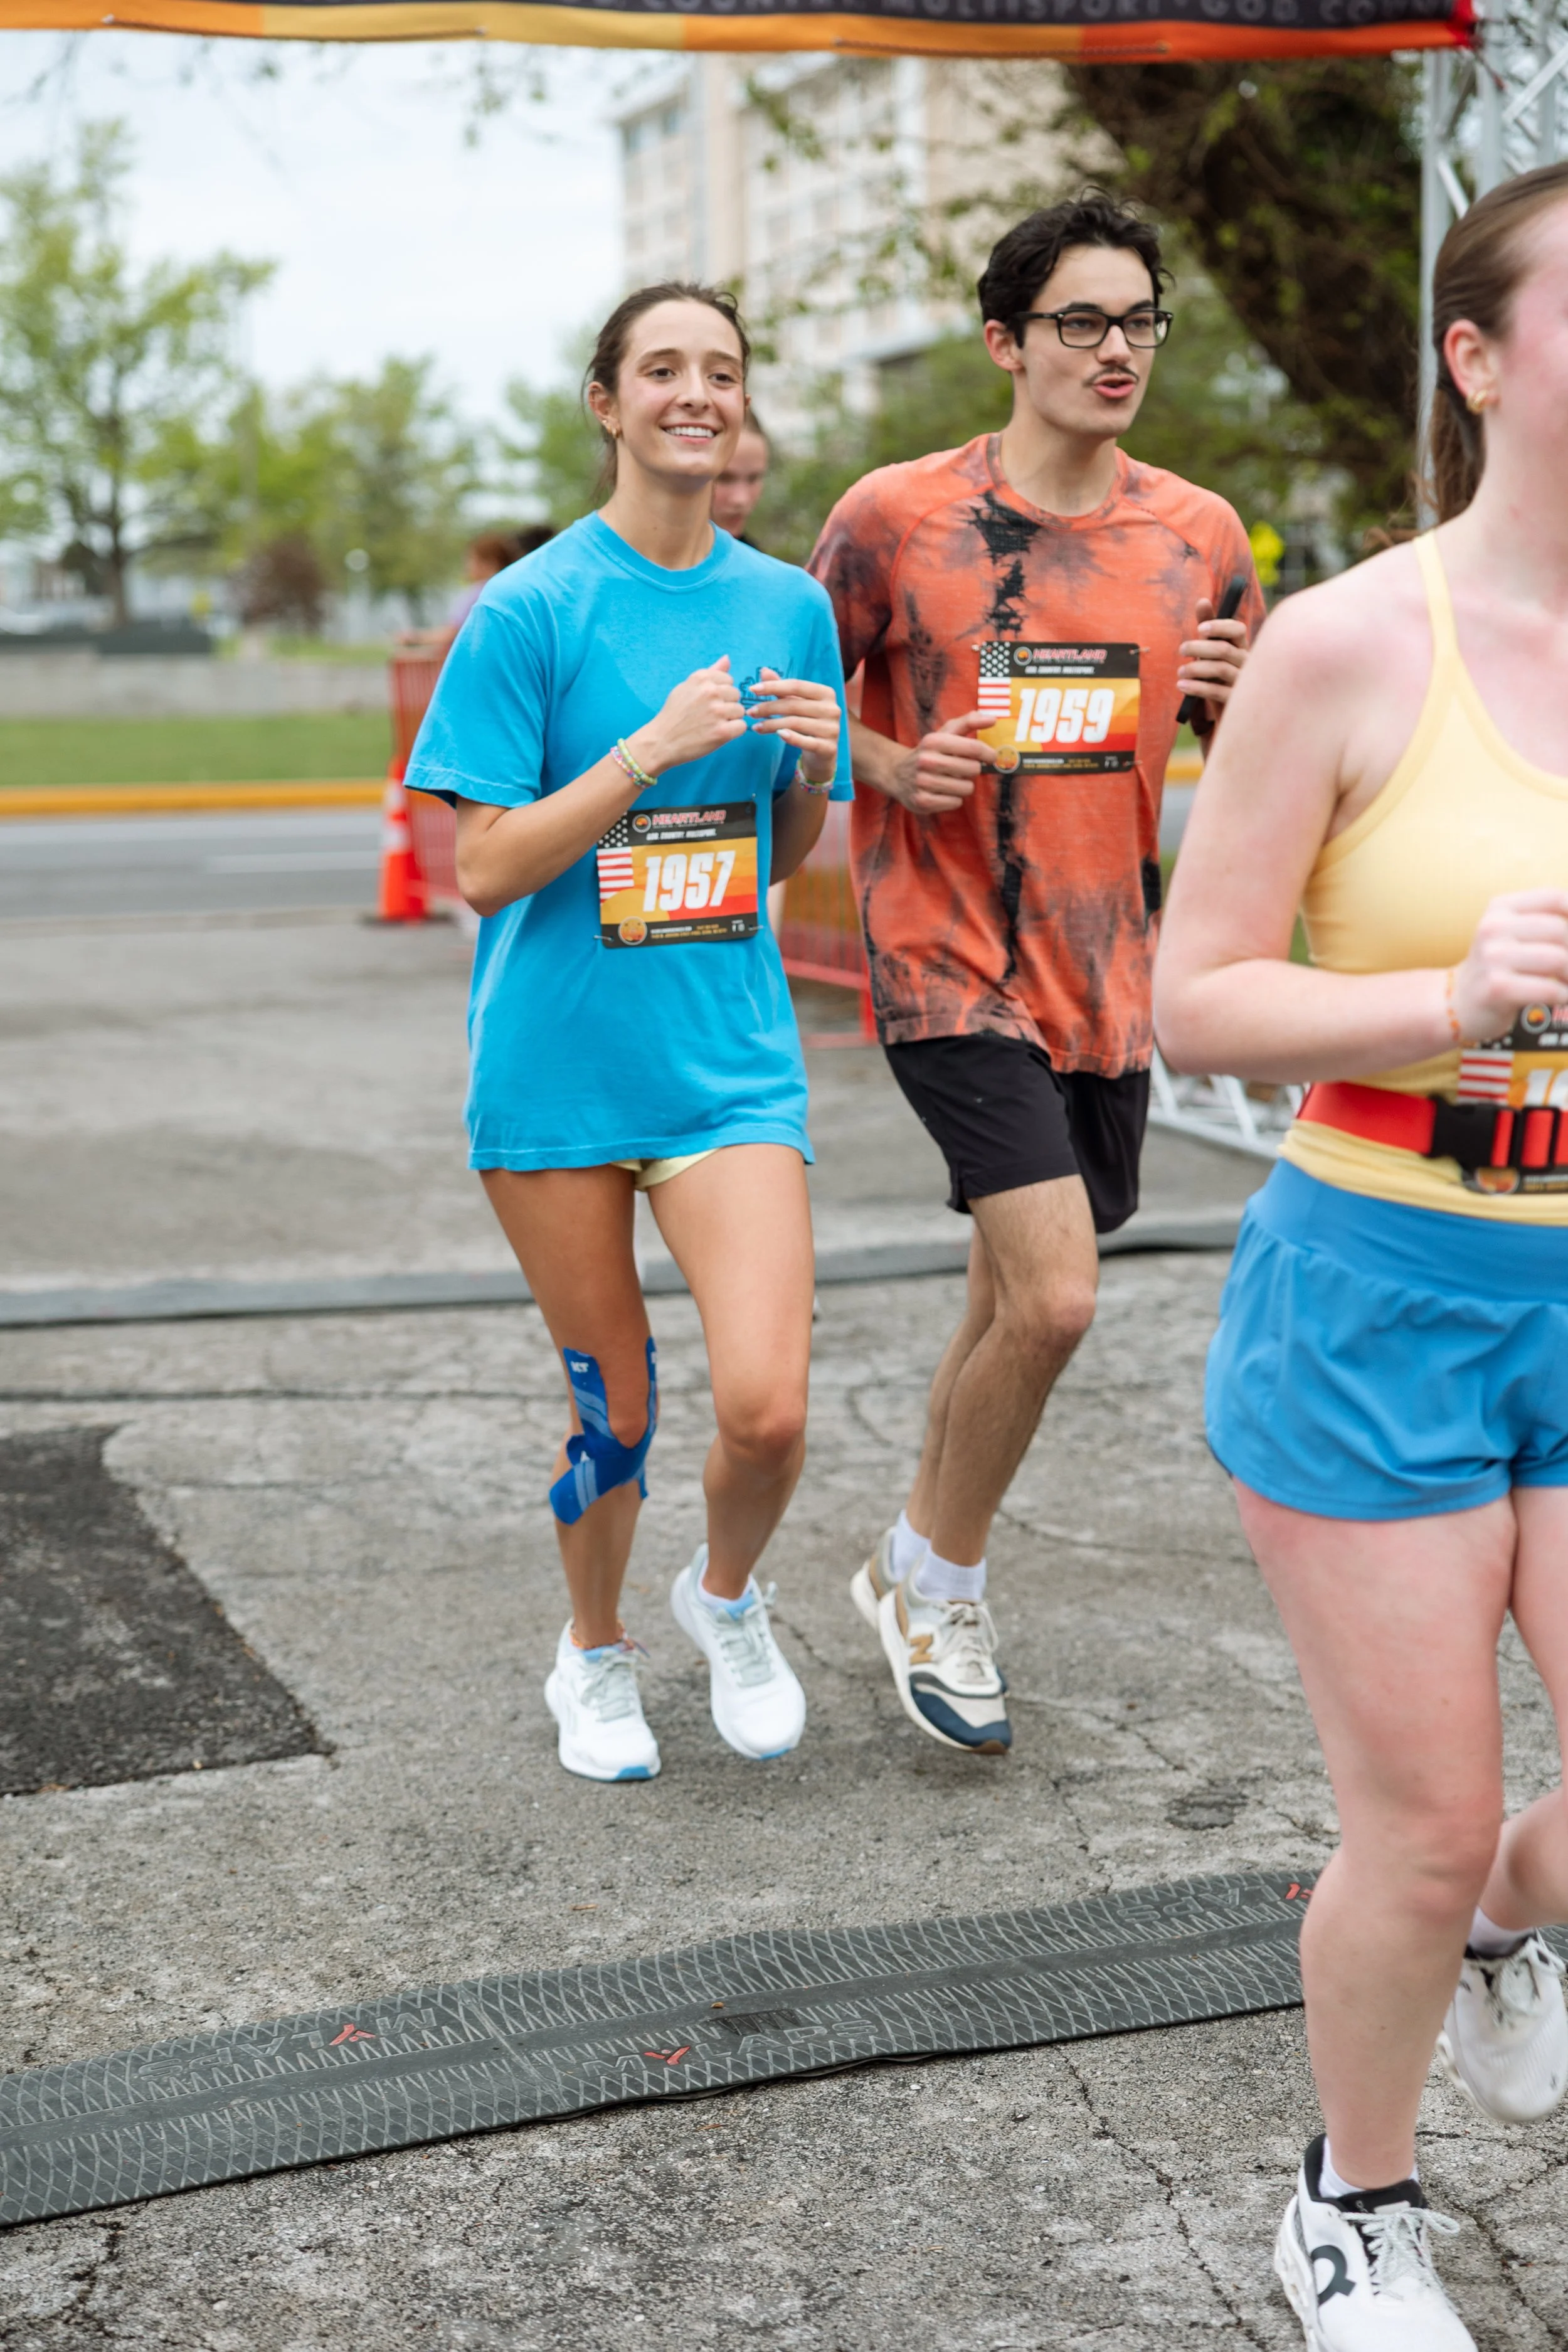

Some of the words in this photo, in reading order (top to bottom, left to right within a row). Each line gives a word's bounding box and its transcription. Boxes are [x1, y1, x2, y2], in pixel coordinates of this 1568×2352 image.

[1034, 649, 1107, 660] HEARTLAND
[1014, 687, 1115, 743] 1959
[652, 810, 726, 824] HEARTLAND
[643, 850, 736, 912] 1957
[1116, 1883, 1313, 1923] LAPS
